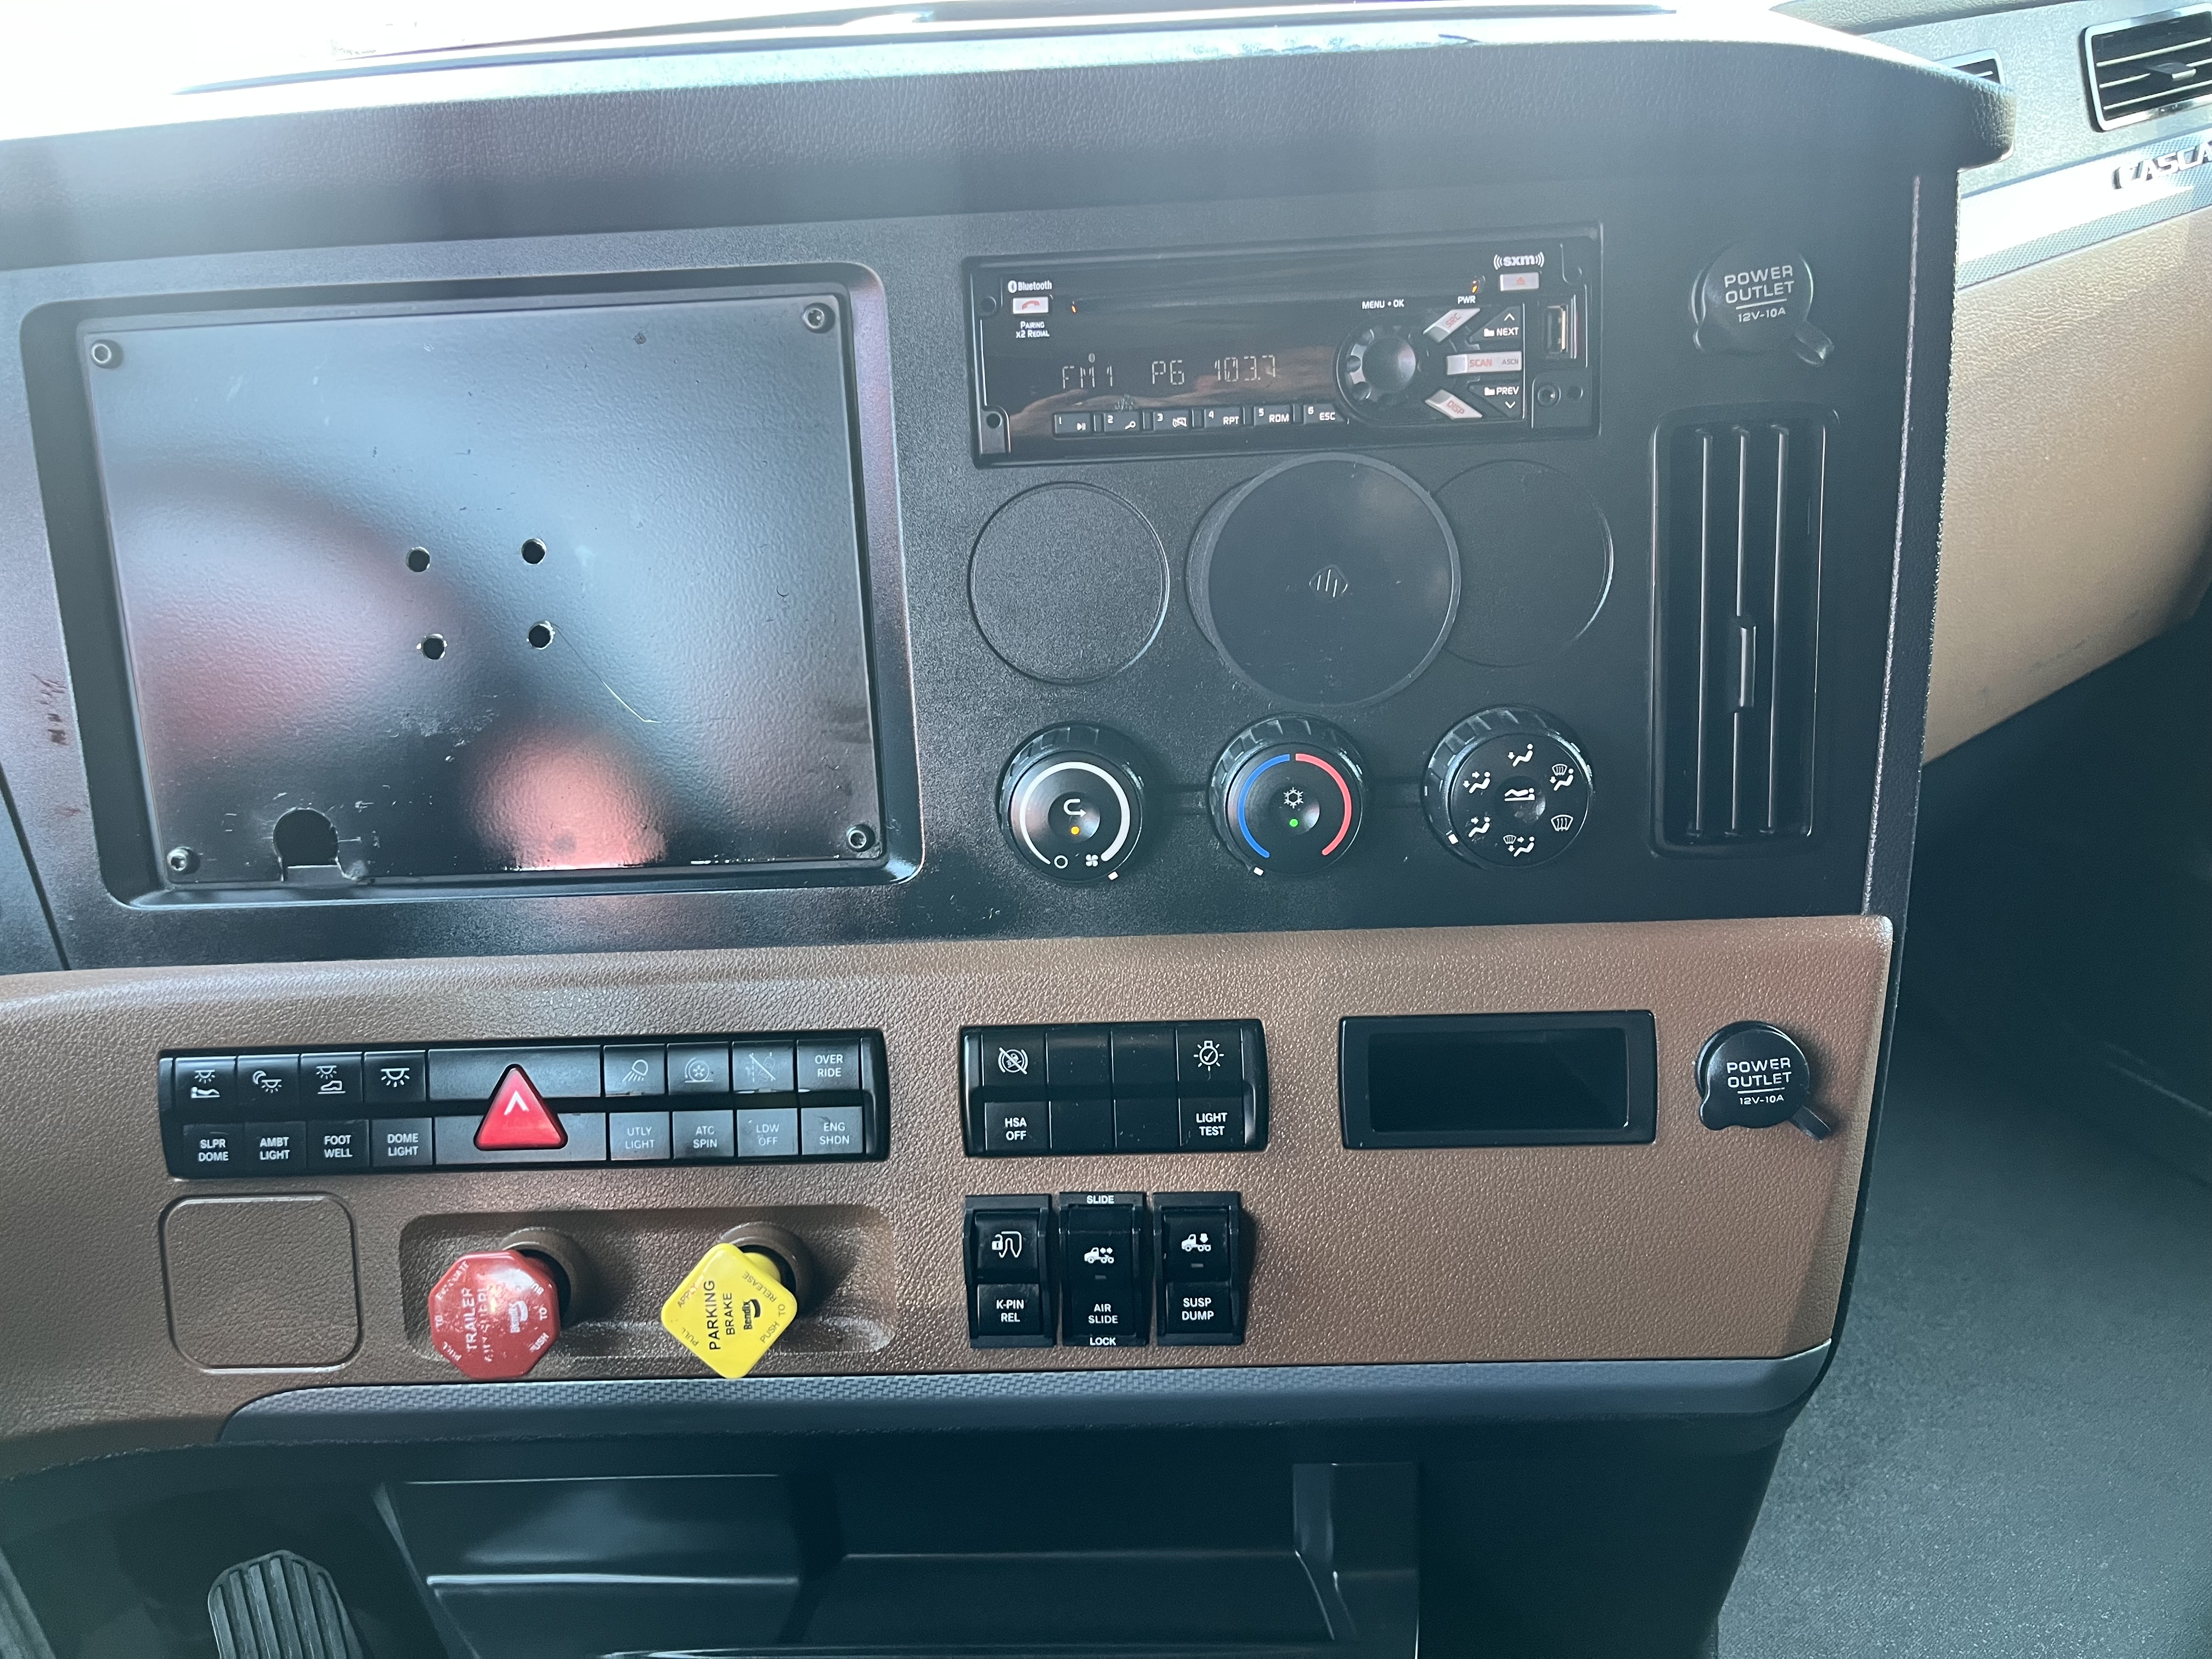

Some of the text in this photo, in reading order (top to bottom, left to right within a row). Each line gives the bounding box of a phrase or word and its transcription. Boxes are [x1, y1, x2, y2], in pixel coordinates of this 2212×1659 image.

[1503, 255, 1536, 267] sxm
[1724, 265, 1793, 287] POWER
[1018, 280, 1052, 291] Bluetooth
[1725, 281, 1795, 304] OUTLET
[1362, 299, 1404, 309] MENU OK
[1457, 295, 1476, 304] PWR
[1738, 307, 1786, 322] 12V-10A
[1446, 313, 1462, 328] SRC
[1497, 327, 1519, 336] NEXT
[1215, 354, 1276, 382] 103.7
[1470, 359, 1492, 367] SCAN
[1496, 386, 1519, 395] PREV
[1447, 400, 1465, 414] DISP
[1158, 413, 1163, 422] 3
[1259, 408, 1264, 417] 5
[1308, 406, 1335, 421] 6 ESC
[1059, 416, 1062, 425] 1
[1108, 415, 1113, 424] 2
[1223, 416, 1239, 426] RPT
[815, 1054, 843, 1065] OVER
[1726, 1057, 1791, 1074] POWER
[817, 1067, 842, 1077] RIDE
[1728, 1071, 1792, 1088] OUTLET
[1740, 1094, 1784, 1104] 12V-10A
[1005, 1118, 1027, 1128] HSA
[1196, 1113, 1227, 1123] LIGHT
[627, 1126, 652, 1137] UTLY
[696, 1126, 715, 1135] ATC
[756, 1123, 780, 1133] LDW
[823, 1122, 845, 1132] ENG
[1199, 1126, 1225, 1136] TEST
[324, 1135, 351, 1145] FOOT
[387, 1133, 419, 1143] DOME
[819, 1135, 850, 1145] SHDN
[1006, 1130, 1026, 1141] OFF
[200, 1139, 226, 1149] SLPR
[260, 1137, 290, 1147] AMBT
[625, 1138, 655, 1149] LIGHT
[692, 1138, 718, 1148] SPIN
[758, 1136, 778, 1146] OFF
[260, 1149, 290, 1160] LIGHT
[324, 1147, 352, 1158] WELL
[388, 1146, 418, 1156] LIGHT
[198, 1152, 229, 1161] DOME
[1086, 1195, 1114, 1204] SLIDE
[742, 1271, 786, 1343] PUSH TO RELEASE
[996, 1300, 1024, 1310] K-PIN
[1183, 1297, 1212, 1307] SUSP
[539, 1306, 547, 1321] TO
[1094, 1304, 1111, 1313] AIR
[461, 1287, 477, 1351] TRAILER
[703, 1280, 721, 1350] PARKING
[723, 1293, 736, 1335] BRAKE
[742, 1300, 753, 1330] Bendix
[1001, 1312, 1020, 1323] REL
[1088, 1314, 1118, 1324] SLIDE
[1182, 1311, 1214, 1321] DUMP
[681, 1327, 699, 1346] PULL
[1090, 1337, 1116, 1346] LOCK
